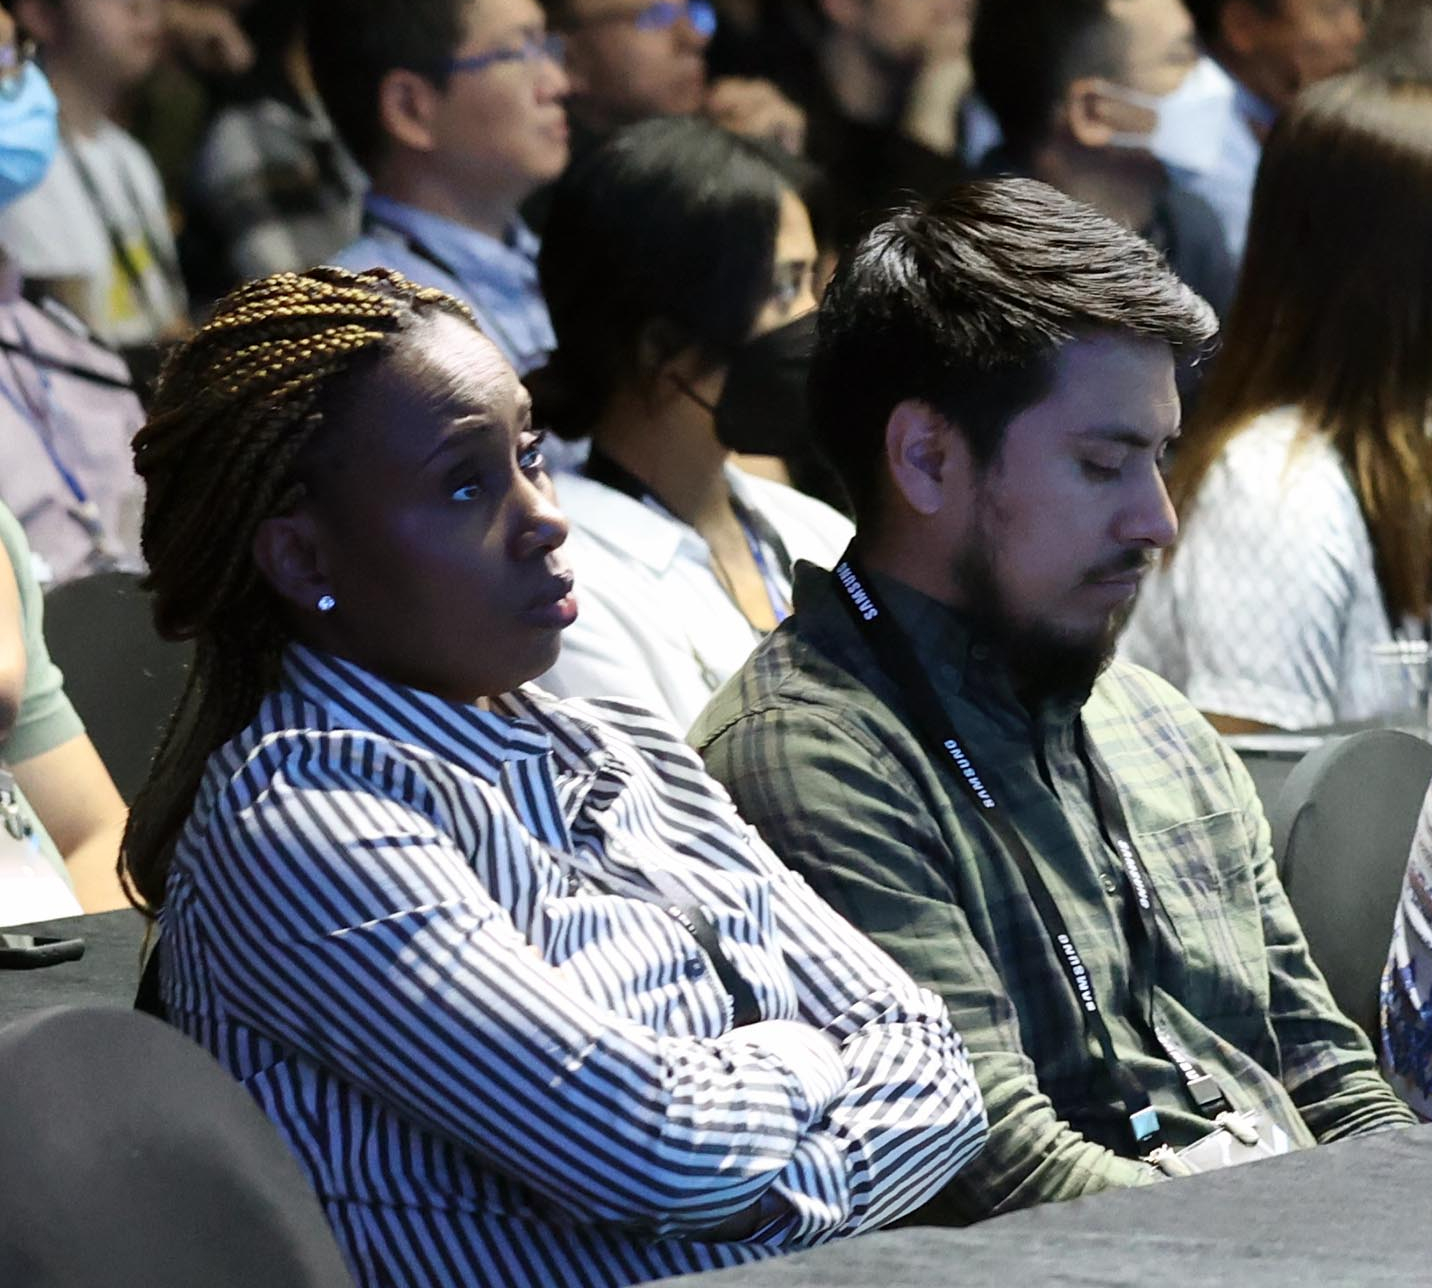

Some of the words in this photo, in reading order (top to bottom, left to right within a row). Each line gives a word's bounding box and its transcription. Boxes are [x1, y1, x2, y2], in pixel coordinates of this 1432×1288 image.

[837, 562, 878, 620] SAMSUNG
[944, 739, 995, 808] SAMSUNG
[1117, 839, 1150, 909] SAMSUNG
[1057, 934, 1096, 1011] SAMSUNG
